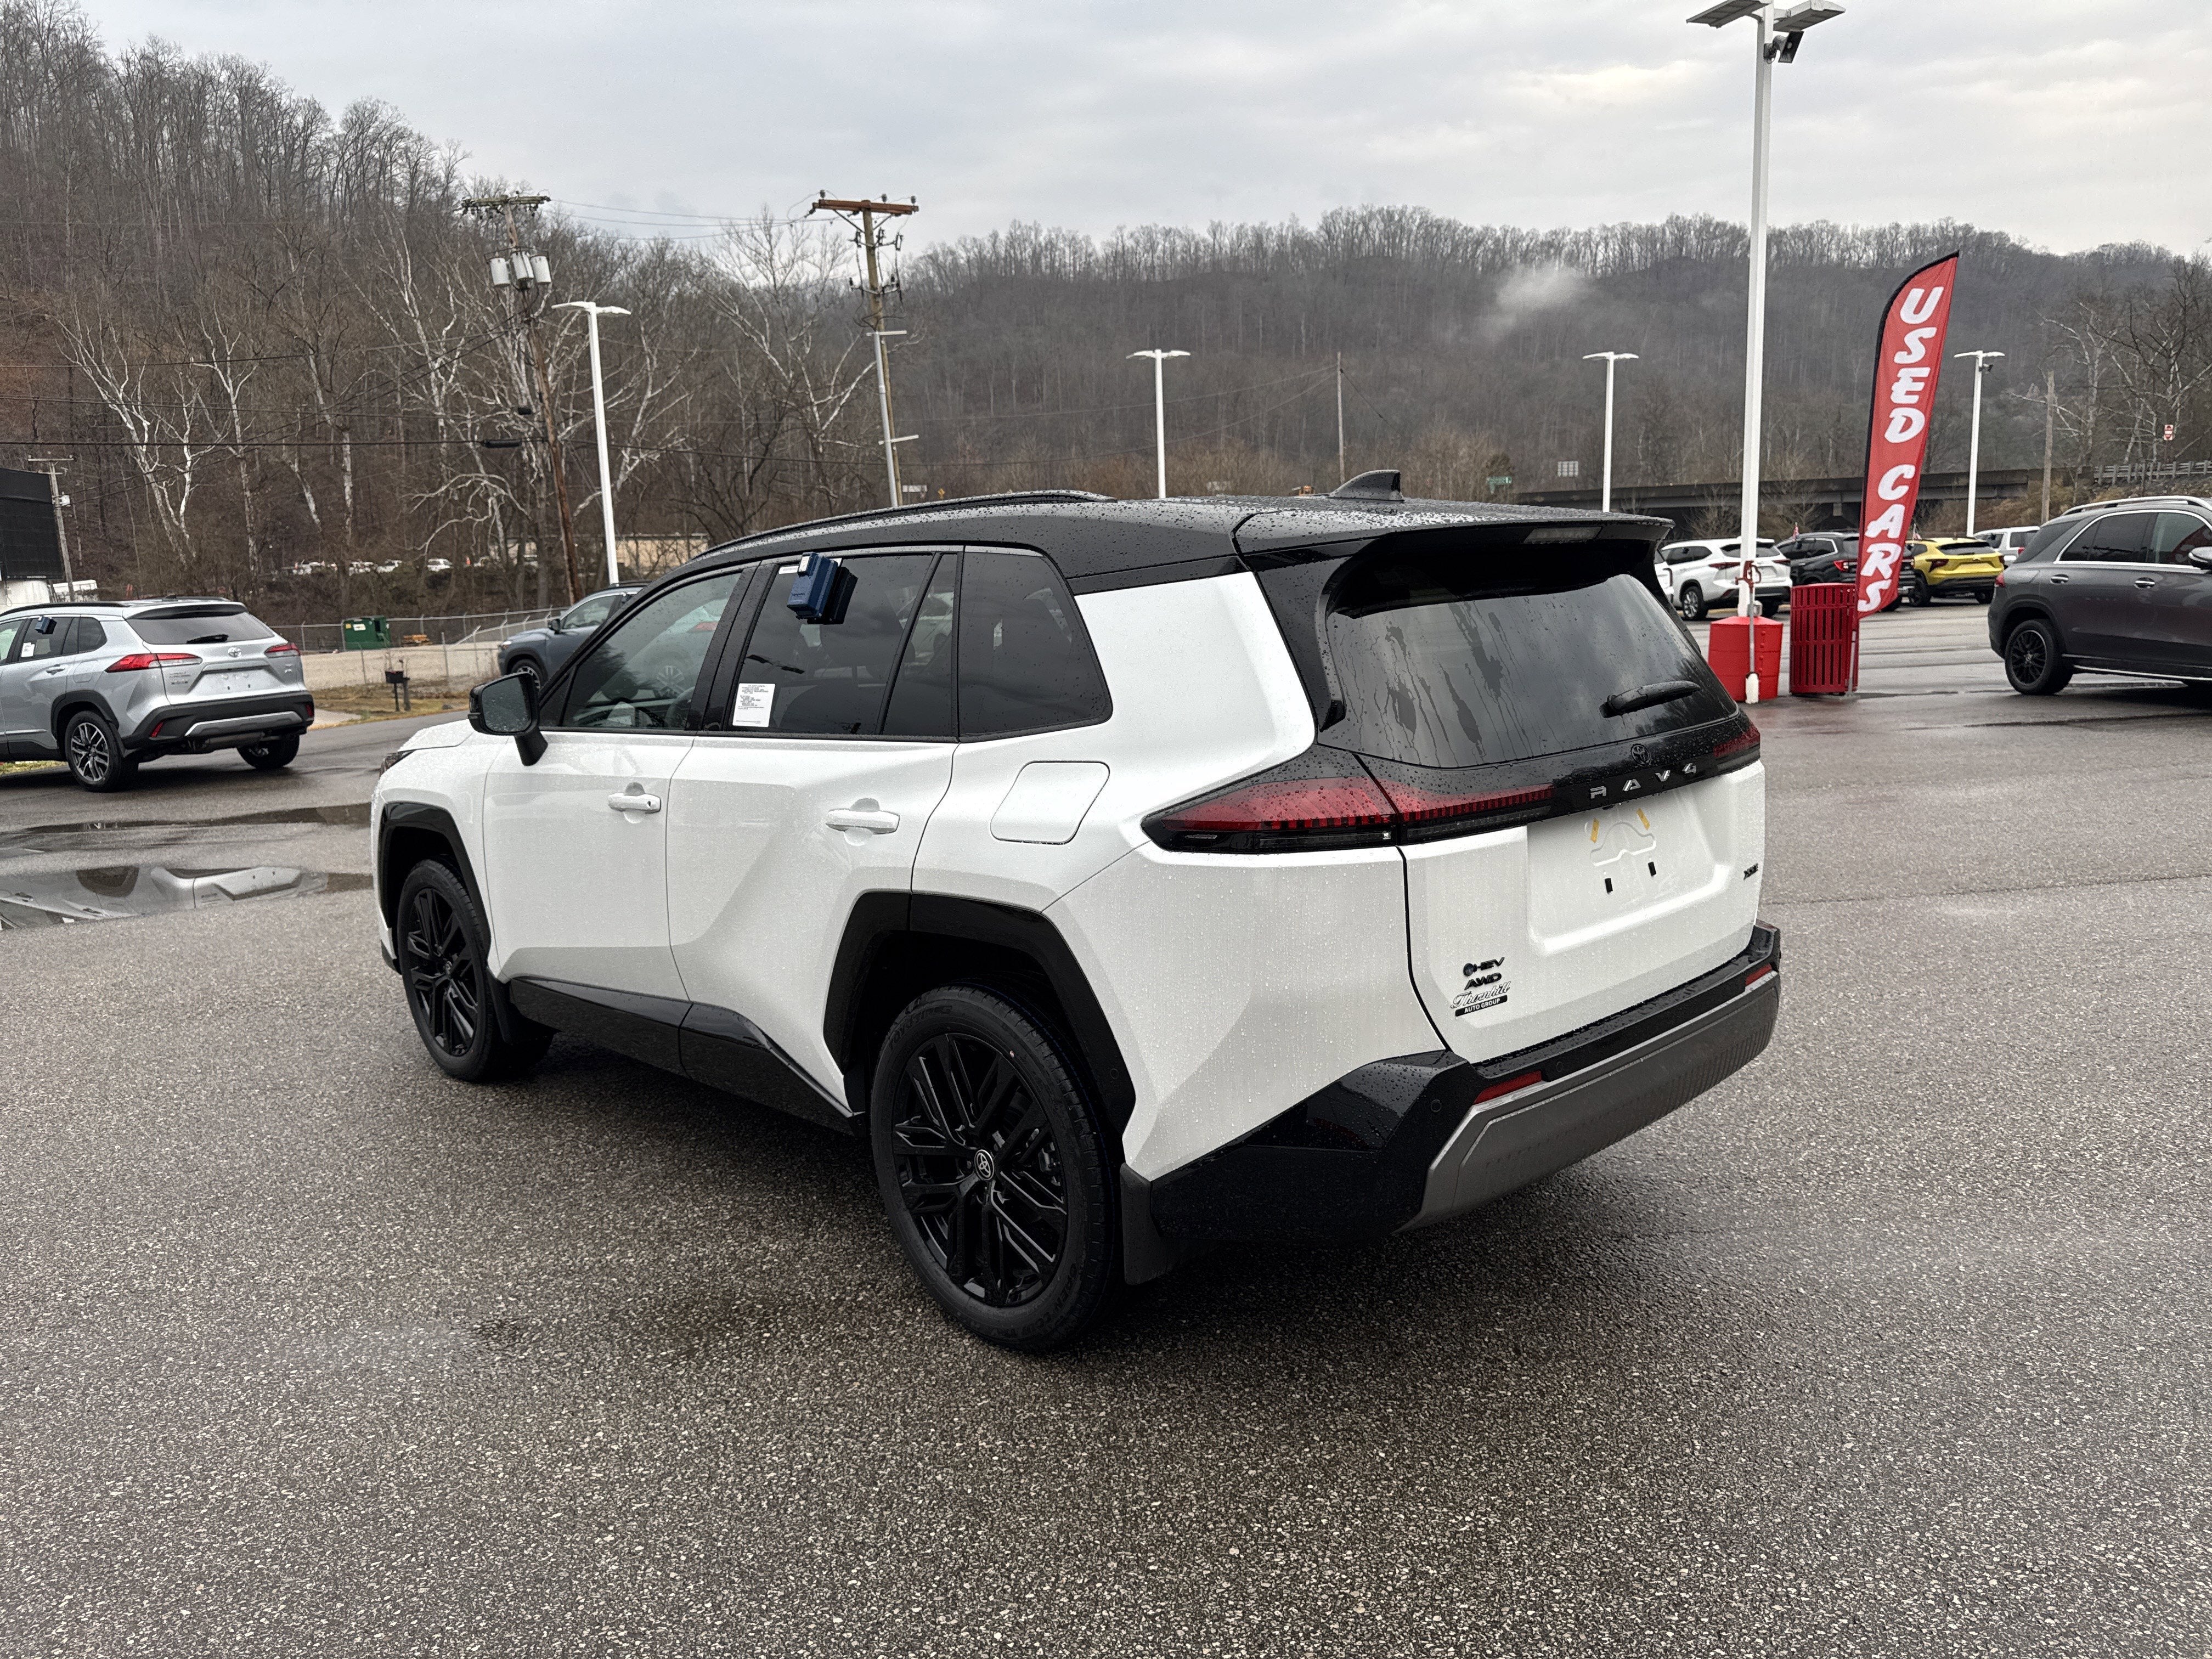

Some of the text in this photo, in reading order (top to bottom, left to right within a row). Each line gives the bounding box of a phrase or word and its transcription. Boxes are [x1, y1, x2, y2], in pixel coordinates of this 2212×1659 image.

[1857, 286, 1944, 612] USED CARS
[1590, 763, 1697, 799] RAV4
[1450, 981, 1511, 1008] Thornhill
[1464, 973, 1502, 990] AWD
[1464, 998, 1500, 1014] AUTO GROUP
